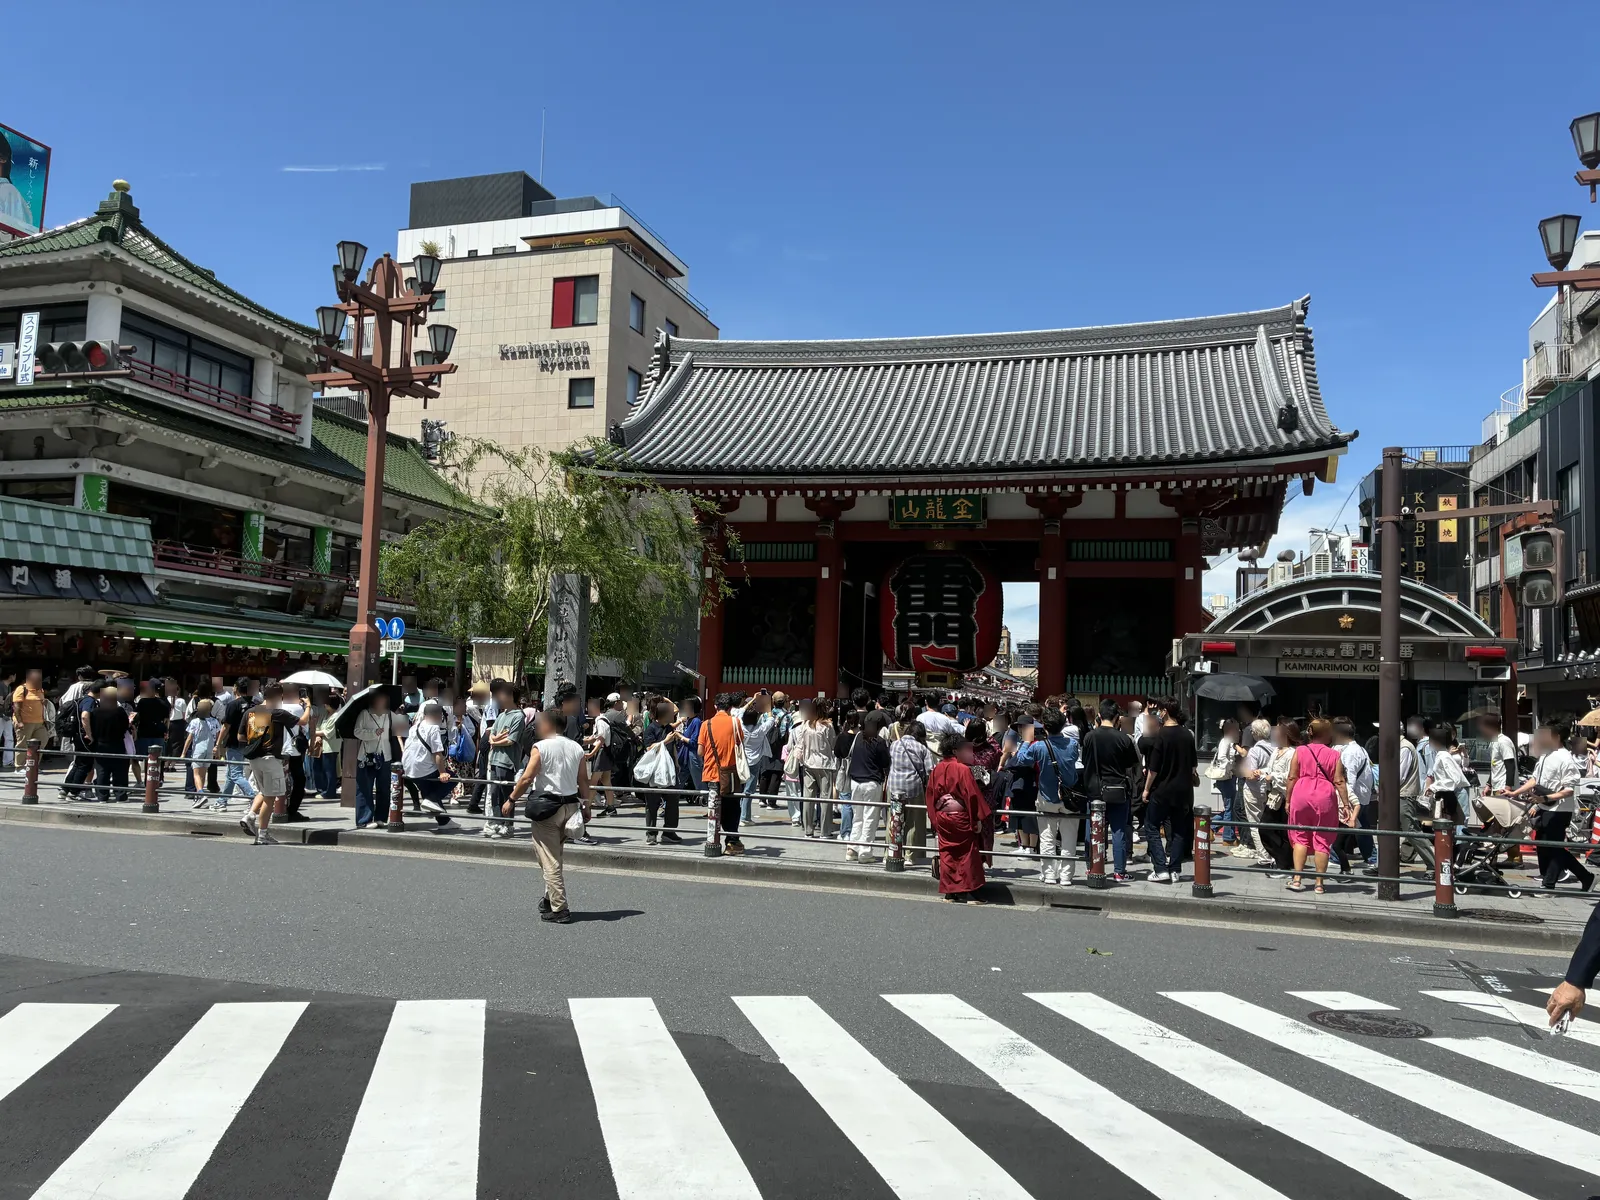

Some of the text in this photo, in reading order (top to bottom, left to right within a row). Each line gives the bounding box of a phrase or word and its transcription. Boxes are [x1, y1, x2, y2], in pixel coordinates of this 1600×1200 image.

[27, 157, 39, 208] 新しくなる
[20, 316, 35, 382] スクランブル式
[498, 340, 590, 357] Kaminarimon
[539, 355, 590, 372] Ryokan
[1414, 492, 1426, 548] KOBE
[1442, 497, 1453, 538] 鉄焼
[889, 554, 986, 673] 雷門
[553, 585, 577, 699] 金龍山浅草
[1340, 642, 1414, 658] 雷門番
[1285, 663, 1358, 672] KAMINARIMON
